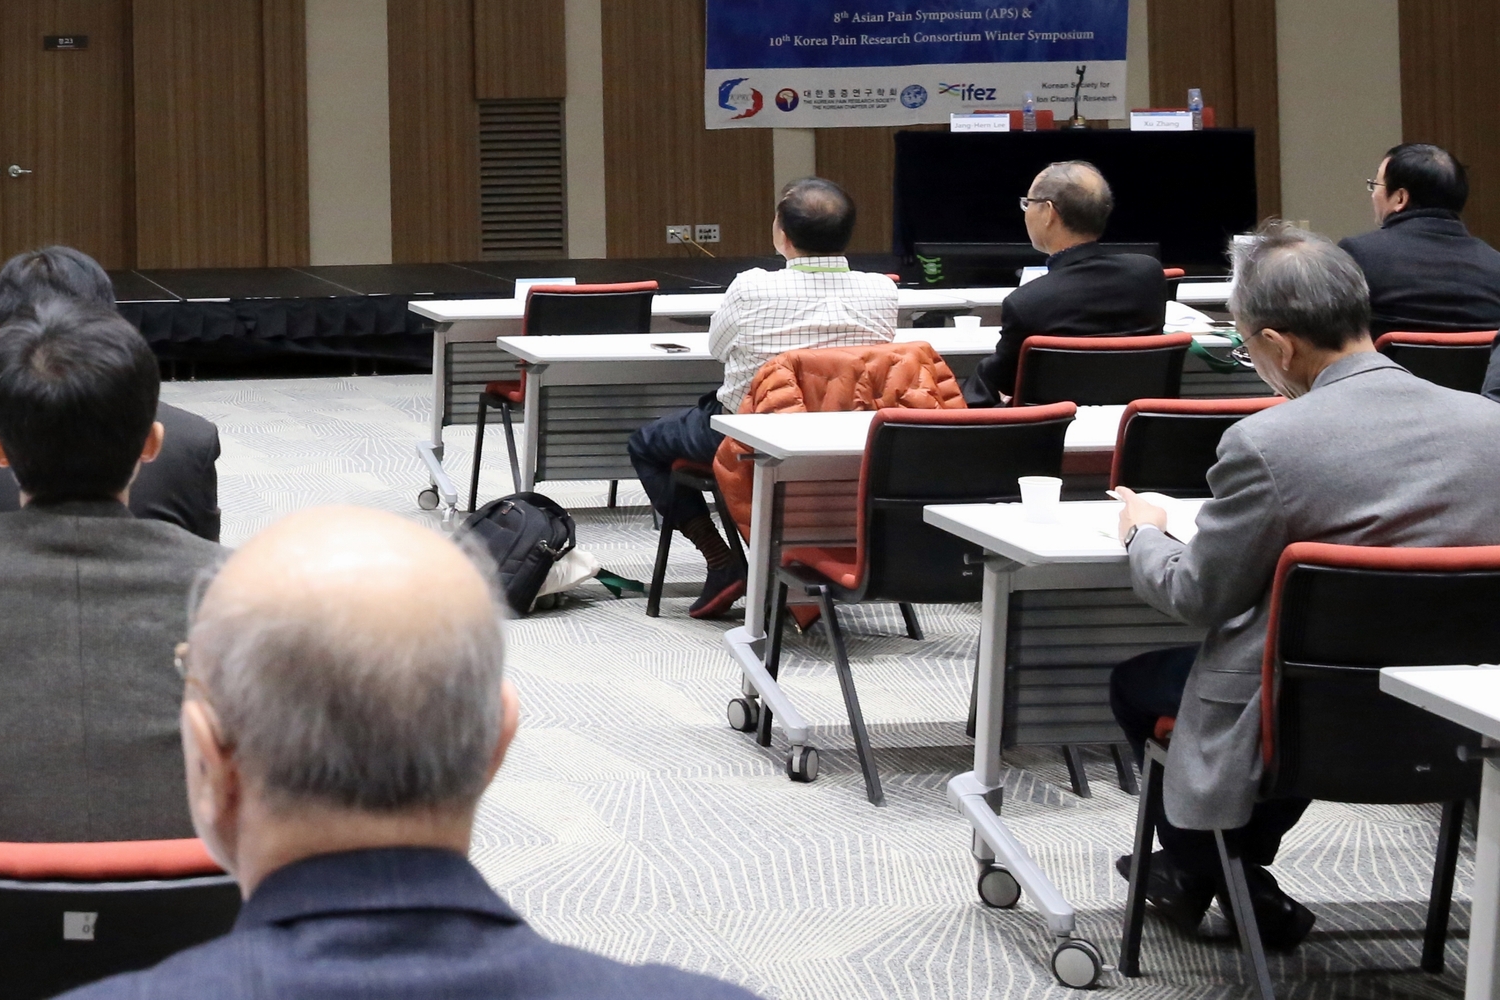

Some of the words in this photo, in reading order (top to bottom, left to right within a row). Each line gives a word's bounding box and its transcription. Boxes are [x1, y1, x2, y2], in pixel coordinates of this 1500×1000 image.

[834, 11, 849, 23] 8th
[852, 12, 884, 23] Asian
[887, 11, 912, 22] Pain
[915, 10, 982, 23] Symposium
[985, 8, 1019, 21] (APS)
[1022, 8, 1032, 19] &
[769, 35, 791, 47] 10th
[794, 35, 828, 46] Korea
[831, 34, 857, 46] Pain
[860, 33, 911, 45] Research
[913, 32, 982, 44] Consortium
[984, 30, 1025, 42] Winter
[1027, 29, 1094, 42] Symposium
[961, 84, 997, 101] ifez
[1083, 94, 1118, 102] Research
[1156, 120, 1180, 128] Zhang
